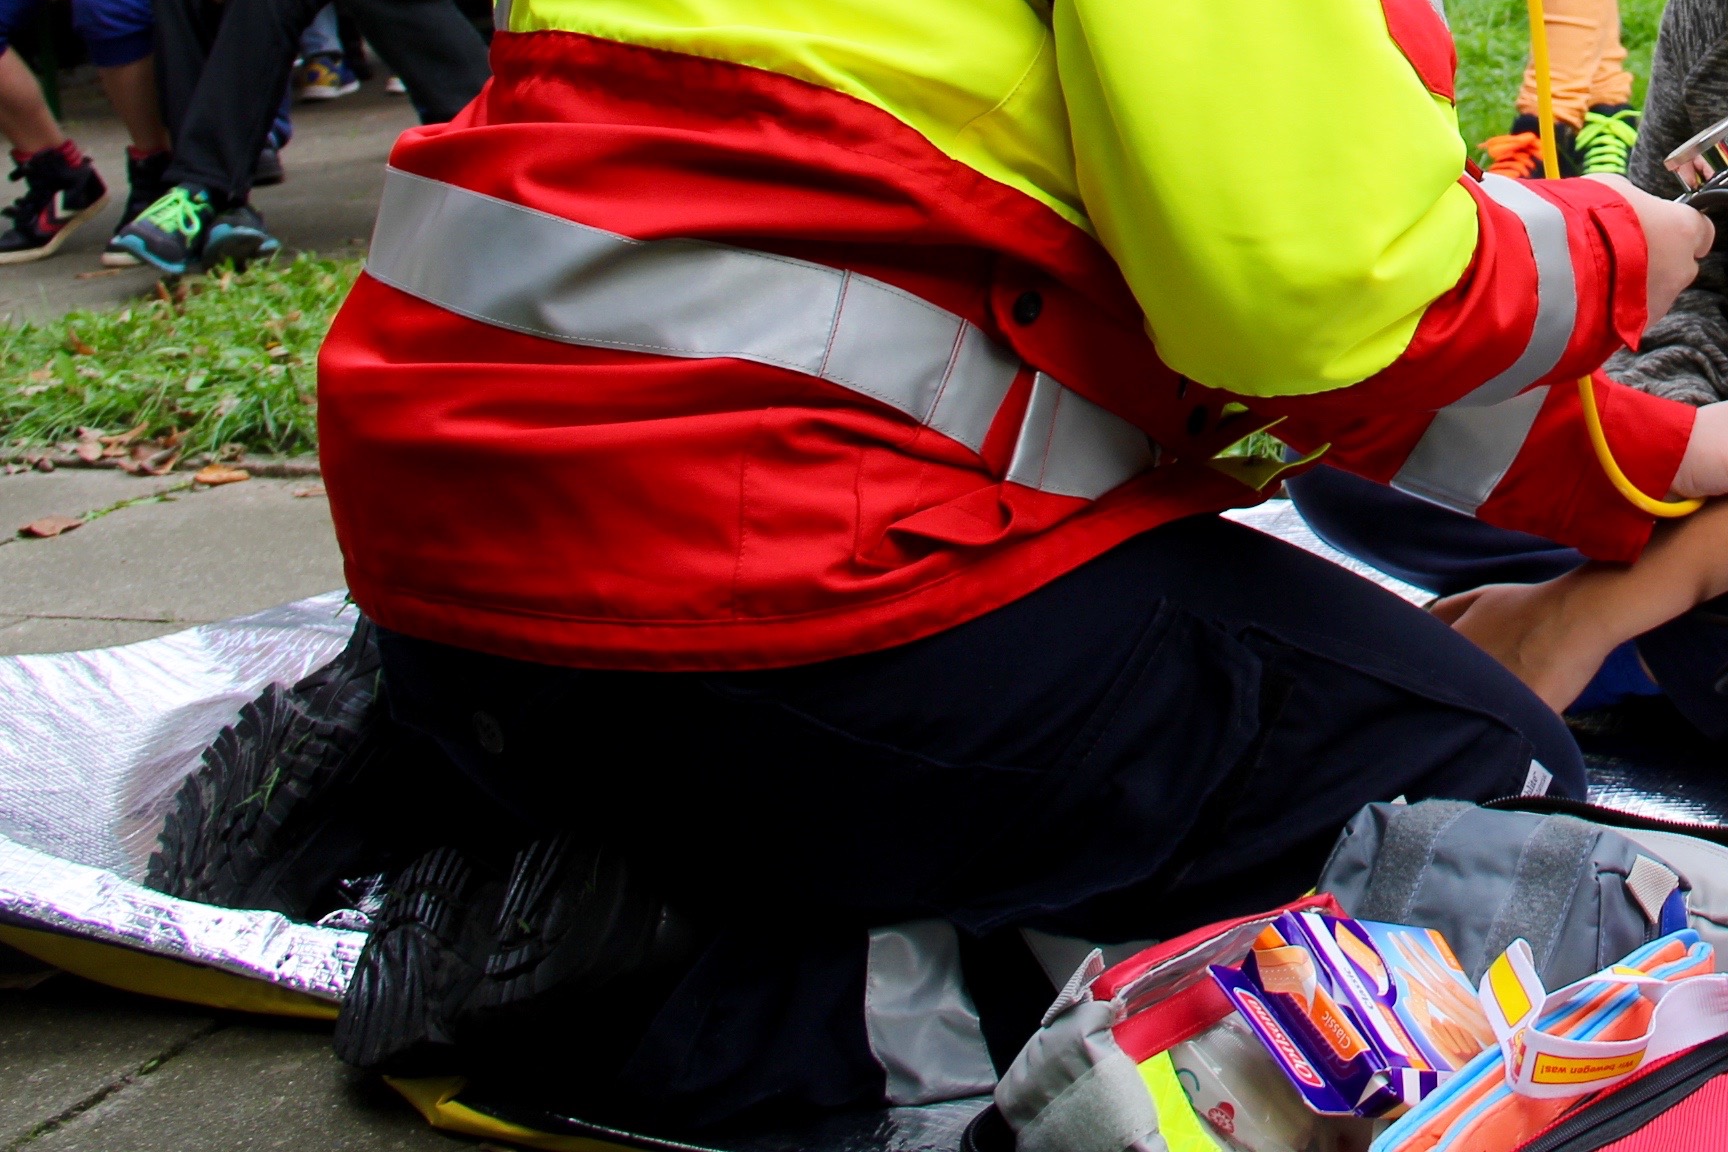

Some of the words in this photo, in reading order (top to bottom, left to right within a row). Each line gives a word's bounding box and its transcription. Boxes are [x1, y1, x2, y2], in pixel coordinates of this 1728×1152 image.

[1343, 966, 1375, 1011] Classic
[1246, 997, 1314, 1080] Optisana
[1320, 1009, 1352, 1051] Classic
[1540, 1065, 1567, 1075] was!
[1570, 1063, 1616, 1075] bewegen
